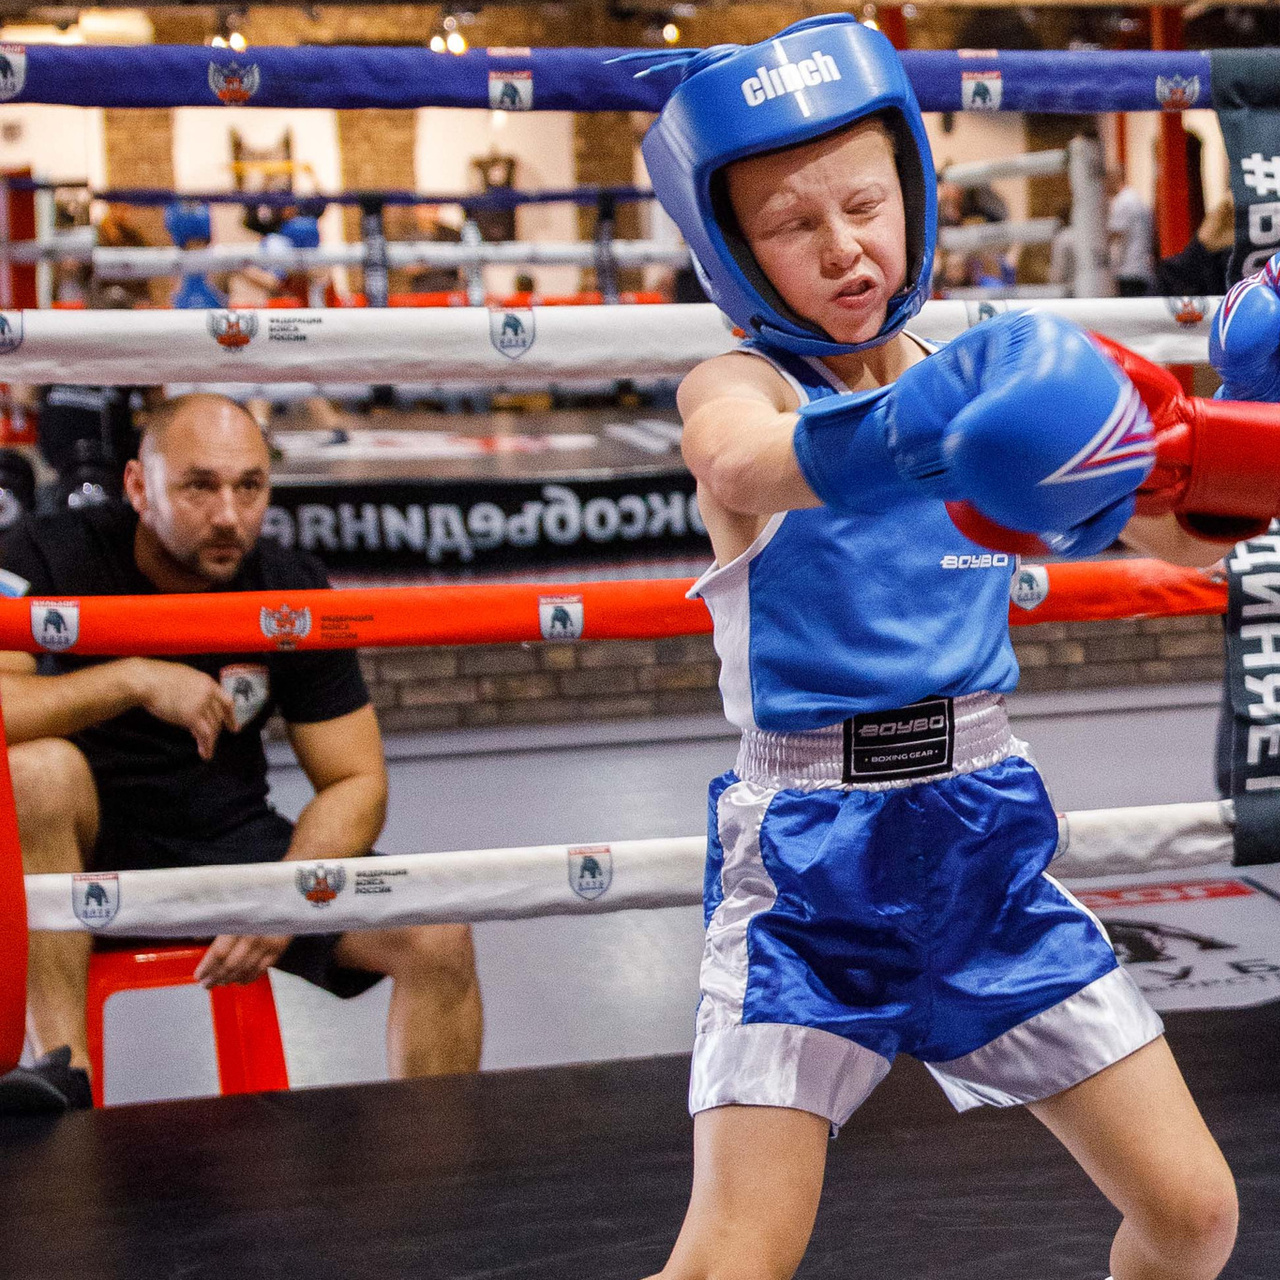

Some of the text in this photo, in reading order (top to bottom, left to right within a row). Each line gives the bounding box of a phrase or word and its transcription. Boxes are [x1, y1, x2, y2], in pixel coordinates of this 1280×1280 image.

[741, 50, 842, 107] clinch
[871, 749, 934, 763] BOXING GEAR
